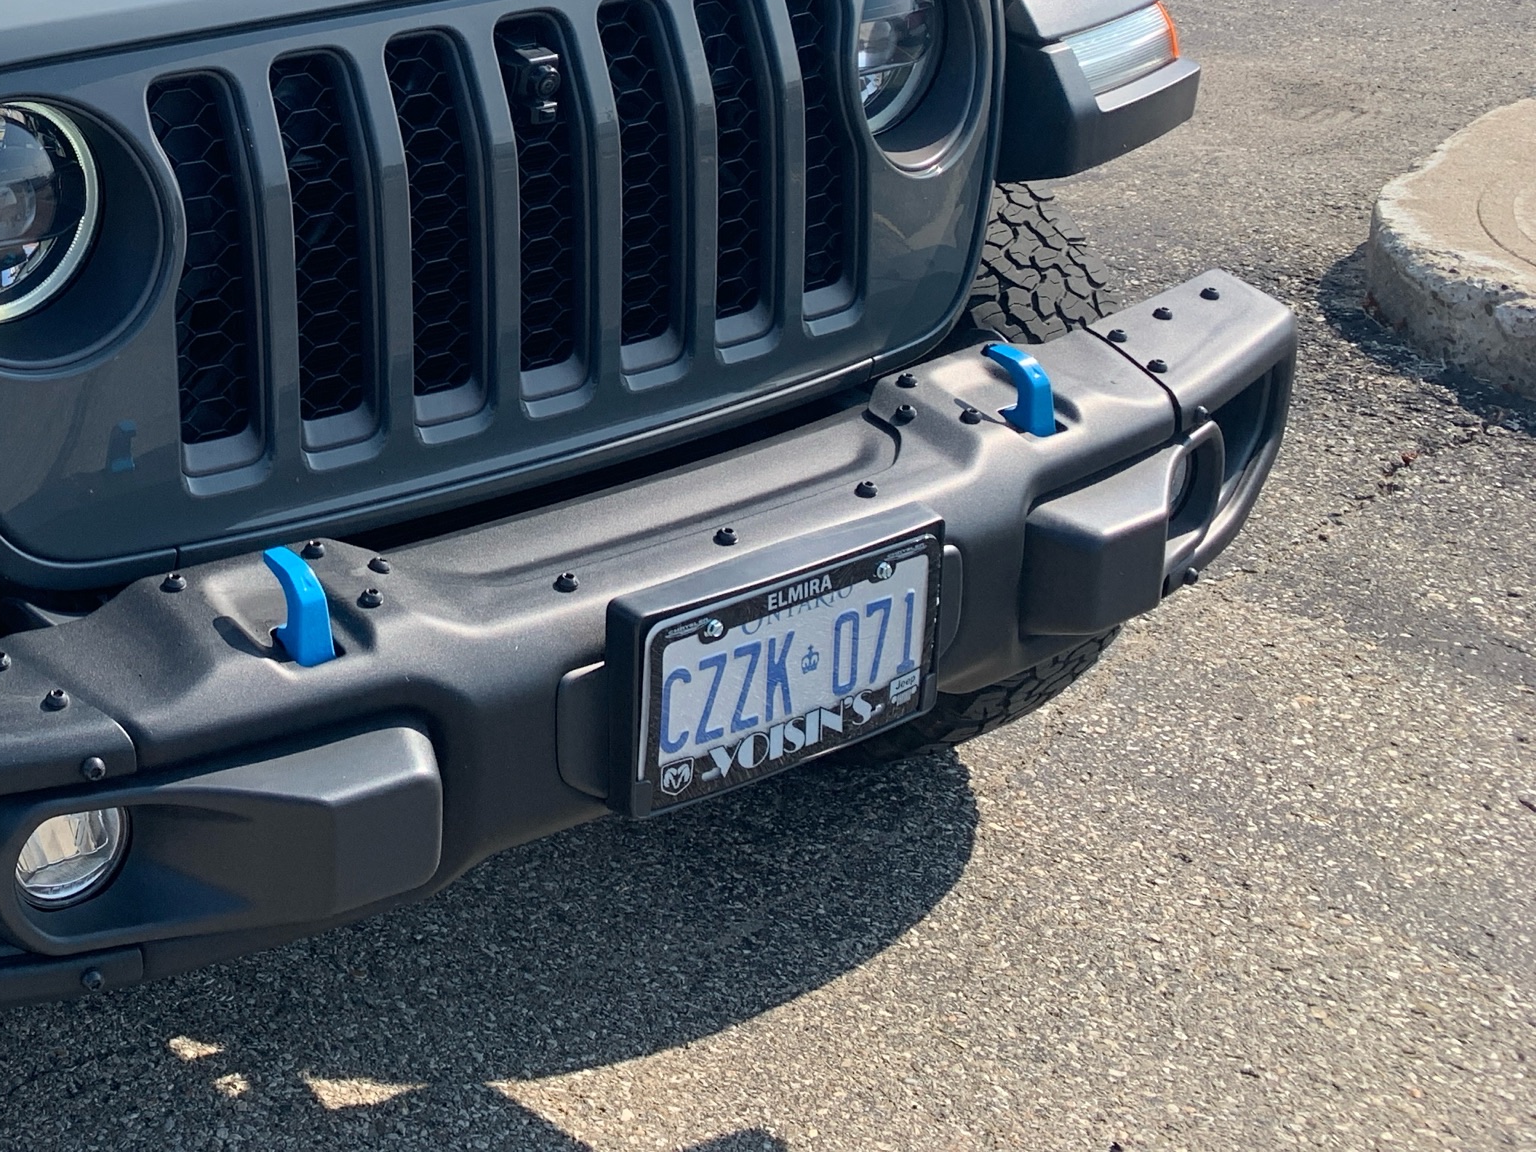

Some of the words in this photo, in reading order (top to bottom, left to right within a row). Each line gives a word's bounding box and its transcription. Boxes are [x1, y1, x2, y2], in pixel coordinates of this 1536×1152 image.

[767, 574, 833, 611] ELMIRA
[660, 630, 795, 754] CZZK
[832, 588, 916, 697] 071
[895, 675, 916, 690] Jeep
[709, 689, 874, 779] VOISIN'S
